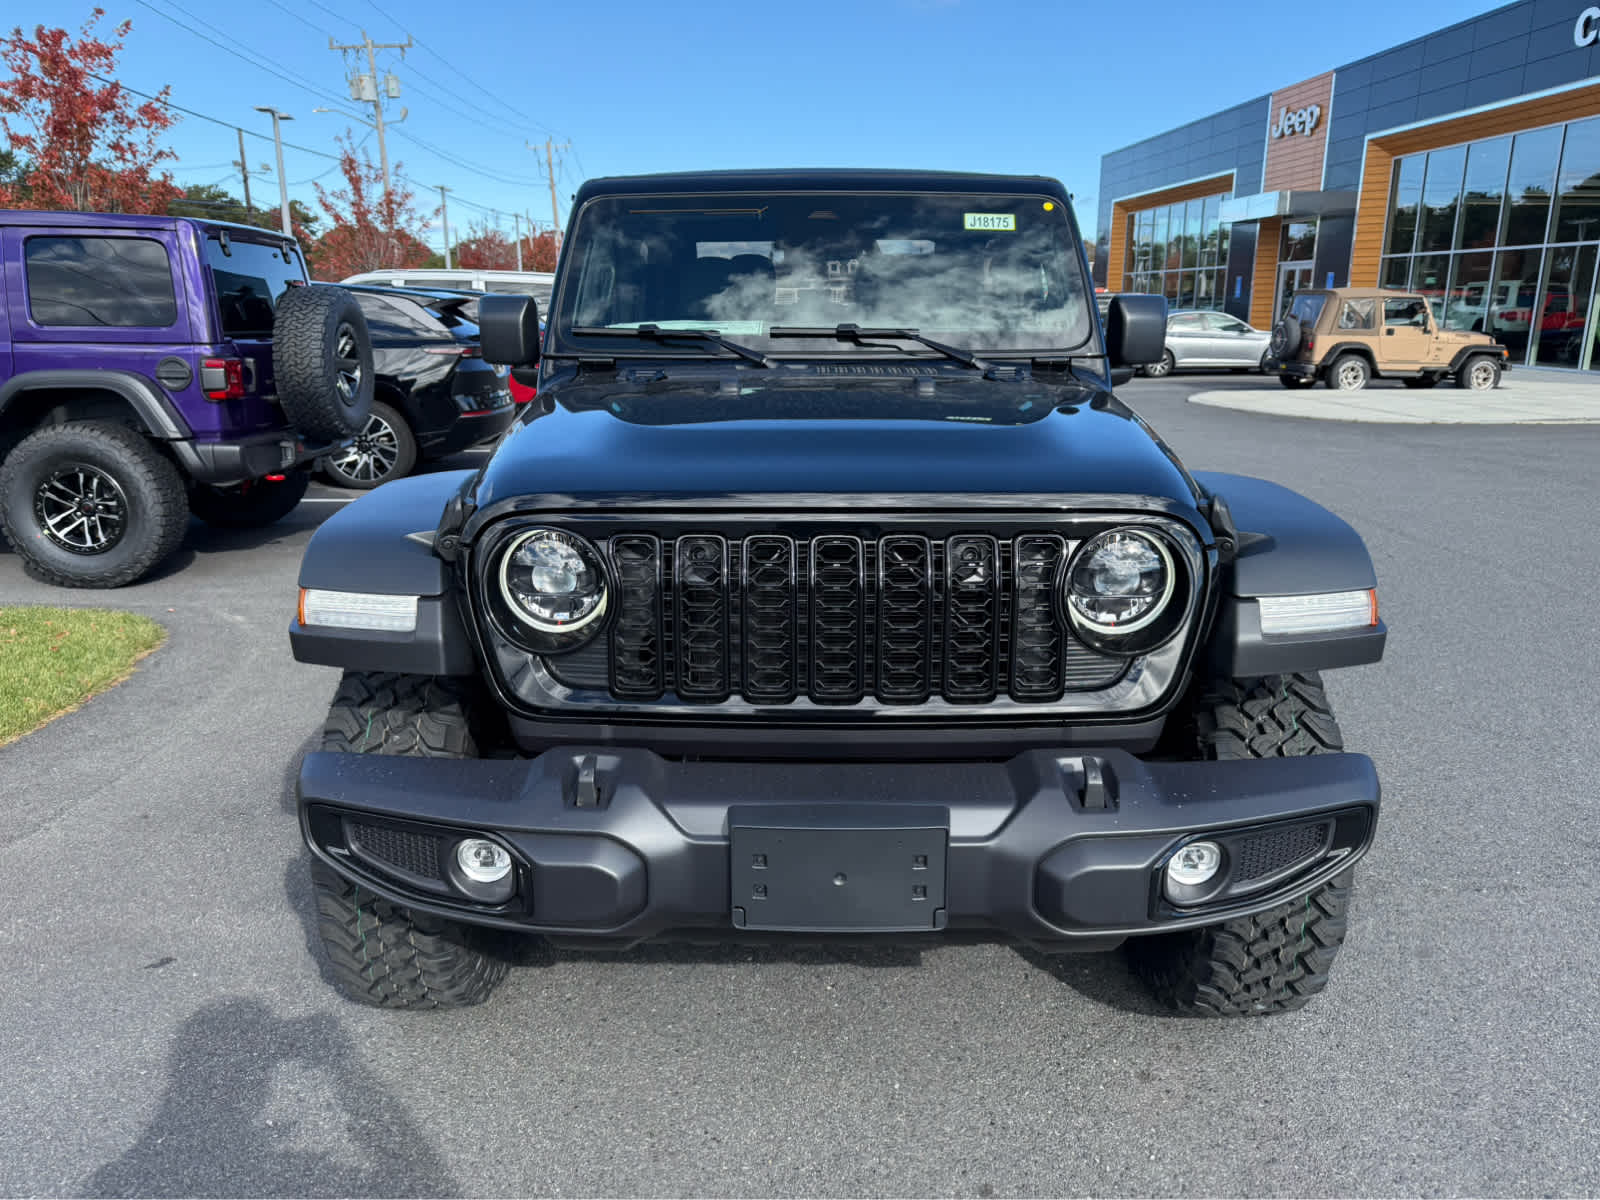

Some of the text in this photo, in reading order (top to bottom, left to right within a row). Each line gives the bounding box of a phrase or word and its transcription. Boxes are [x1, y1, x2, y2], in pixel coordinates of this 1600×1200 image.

[1574, 6, 1600, 47] C
[1272, 104, 1320, 138] Jeep
[969, 215, 1009, 229] J18175
